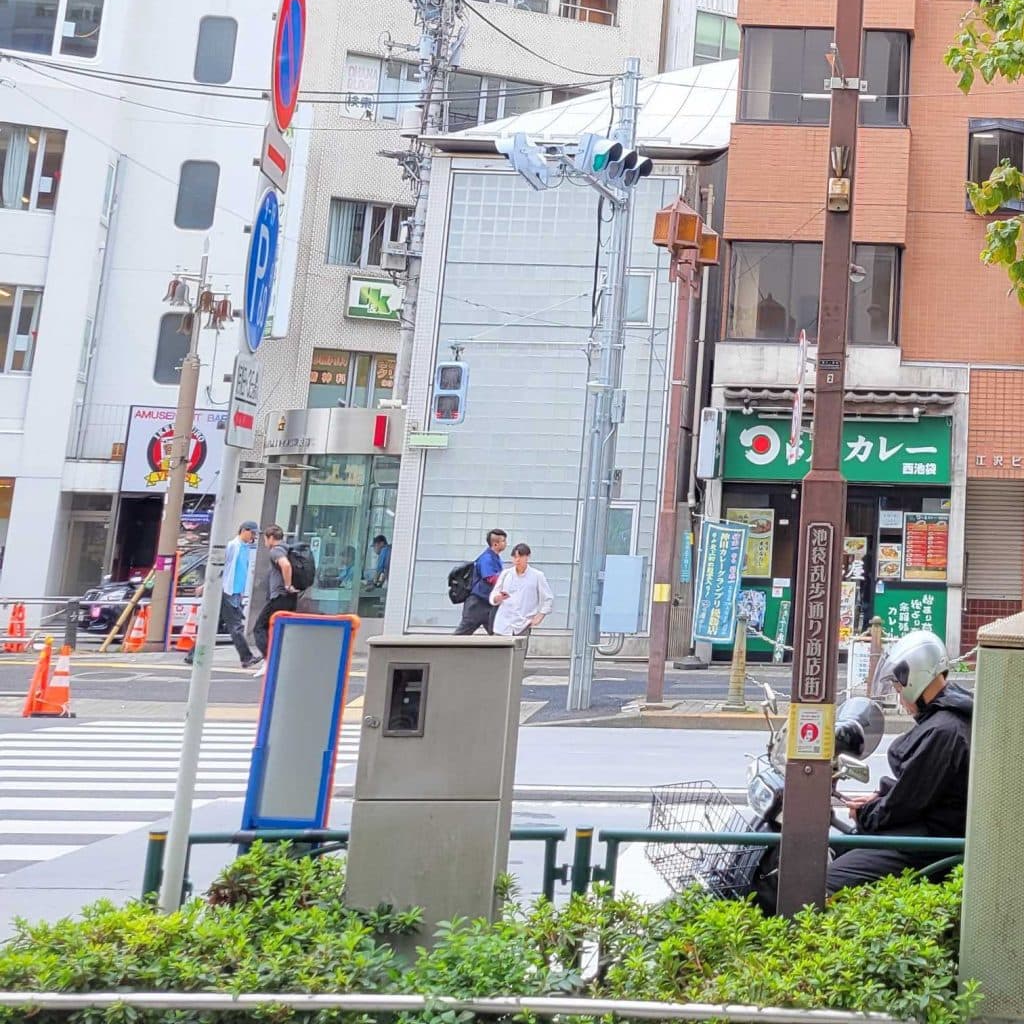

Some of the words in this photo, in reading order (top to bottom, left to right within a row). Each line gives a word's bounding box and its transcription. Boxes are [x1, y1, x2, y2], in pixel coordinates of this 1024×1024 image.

[135, 410, 200, 421] AMUSET
[902, 463, 937, 475] 西池袋
[803, 528, 828, 696] 池袋乱歩通り商店街
